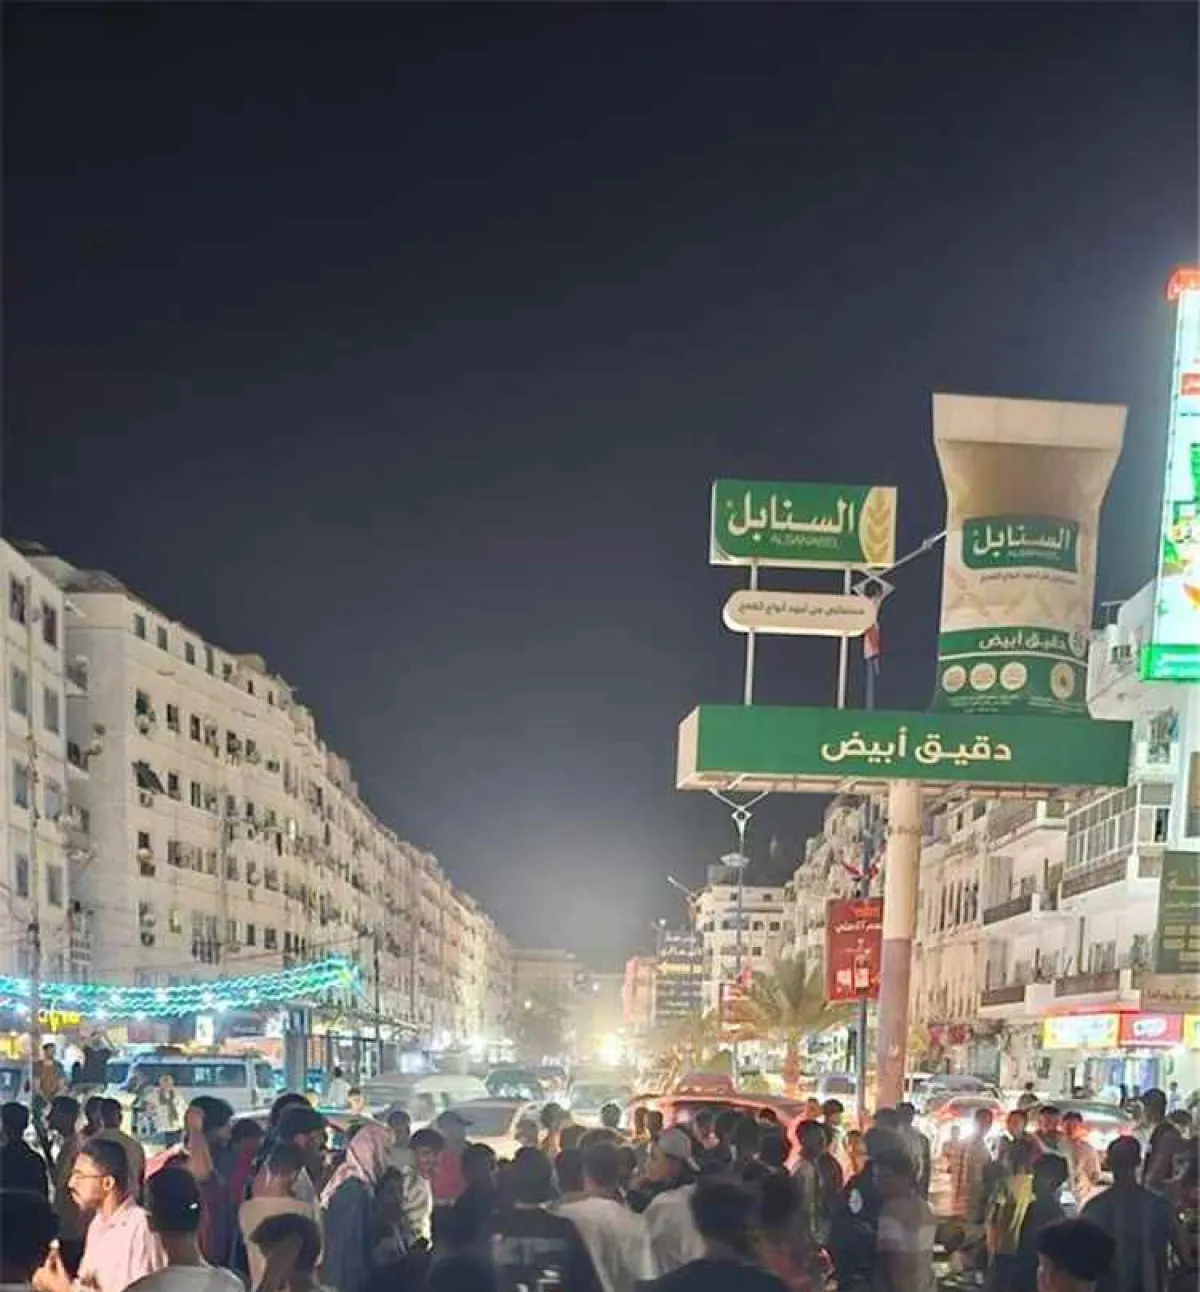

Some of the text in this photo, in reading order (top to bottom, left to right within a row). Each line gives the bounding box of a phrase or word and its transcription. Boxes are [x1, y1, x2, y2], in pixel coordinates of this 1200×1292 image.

[727, 489, 854, 541] السنابل
[972, 524, 1070, 557] السنابل
[978, 629, 1066, 650] دقيق أبيض
[820, 725, 1012, 766] دقيق أبيض
